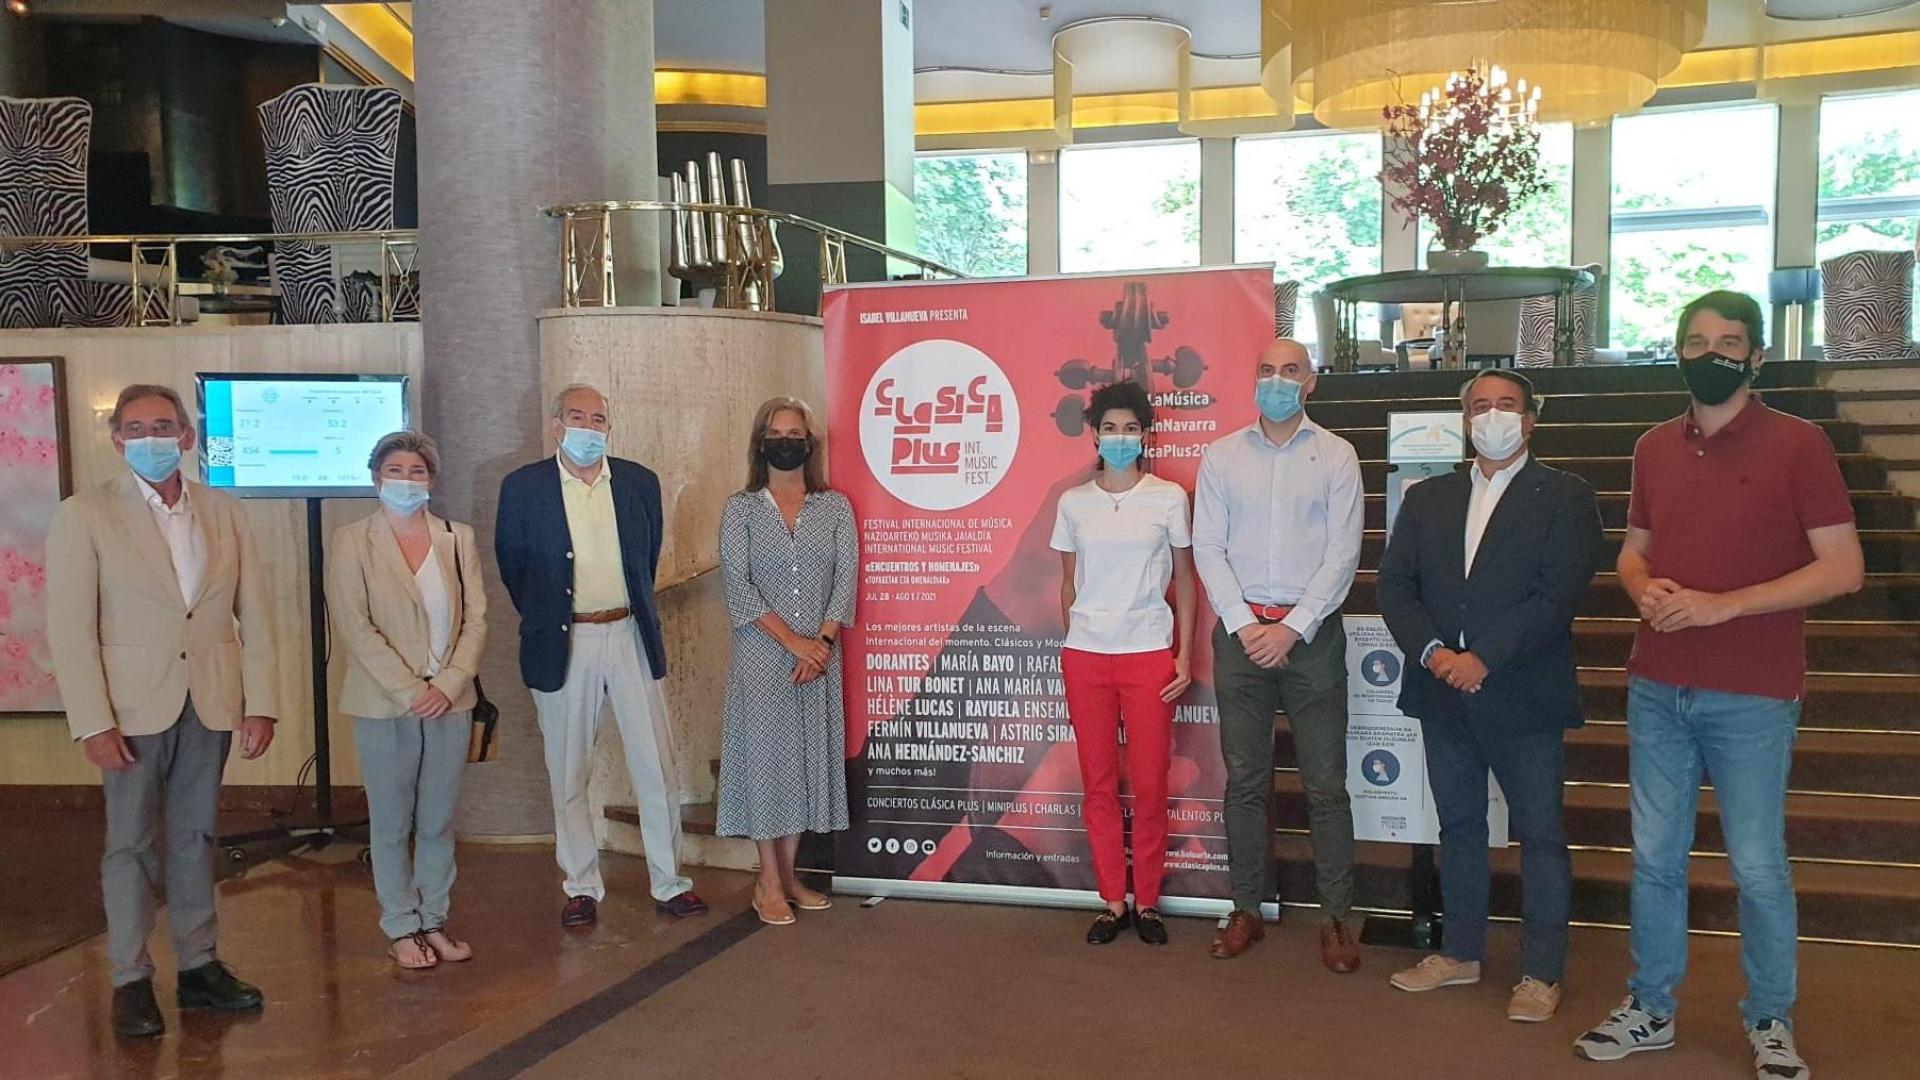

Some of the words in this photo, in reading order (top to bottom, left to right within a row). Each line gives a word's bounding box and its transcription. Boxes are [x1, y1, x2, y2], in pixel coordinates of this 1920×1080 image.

[860, 312, 884, 324] ISABEL
[885, 310, 928, 323] VILLANUEVA
[929, 309, 968, 321] PRESENTA
[1147, 391, 1209, 406] LaMúsica
[1151, 418, 1216, 432] nNavarra
[965, 441, 983, 454] INT.
[965, 456, 998, 469] MUSIC
[965, 472, 992, 485] FEST.
[863, 518, 899, 529] FESTIVAL
[902, 518, 966, 529] INTERNACIONAL
[968, 518, 979, 528] DE
[981, 516, 1013, 528] MÚSICA
[864, 531, 919, 541] NAZIOARTEKO
[921, 531, 952, 541] MUSIKA
[954, 530, 991, 540] JAIALDIA
[865, 543, 926, 553] INTERNATIONAL
[929, 543, 954, 553] MUSIC
[956, 543, 993, 553] FESTIVAL
[921, 562, 926, 572] Y
[865, 592, 879, 601] JUL
[879, 592, 890, 601] 28
[895, 592, 910, 601] AGO
[921, 592, 936, 601] 2021
[866, 622, 882, 631] Los
[885, 622, 922, 634] mejores
[924, 623, 960, 632] artistas
[962, 623, 974, 632] de
[976, 624, 985, 632] la
[866, 637, 926, 647] Internacional
[928, 637, 943, 647] del
[946, 639, 992, 647] momento.
[994, 637, 1034, 648] Clásicos
[1037, 641, 1042, 649] y
[866, 653, 929, 671] DORANTES
[941, 650, 979, 672] MARÍA
[982, 655, 1014, 672] BAYO
[1026, 656, 1062, 673] RAFAE
[867, 676, 893, 693] LINA
[897, 676, 921, 693] TUR
[925, 677, 964, 694] BONET
[976, 678, 1000, 694] ANA
[1004, 674, 1043, 695] MARÍA
[867, 694, 912, 716] HÉLÈNE
[915, 699, 954, 717] LUCAS
[965, 700, 1020, 718] RAYUELA
[1024, 701, 1071, 719] ENSEM
[1172, 705, 1221, 723] ANUEV
[867, 716, 912, 738] FERMÍN
[916, 722, 989, 740] VILLANUEVA
[1000, 724, 1043, 742] ASTRIG
[1047, 724, 1077, 742] SIRA
[867, 743, 892, 760] ANA
[895, 740, 1024, 764] HERNÁNDEZ-SANCHIZ
[867, 768, 873, 776] y
[876, 766, 912, 776] muchos
[914, 767, 936, 777] más!
[867, 797, 918, 809] CONCIERTOS
[920, 796, 955, 810] CLÁSICA
[958, 800, 979, 812] PLUS
[987, 801, 1027, 814] MINIPLUS
[1034, 803, 1076, 816] CHARLAS
[986, 850, 1034, 861] Información
[1036, 854, 1041, 862] y
[1043, 854, 1079, 863] entradas
